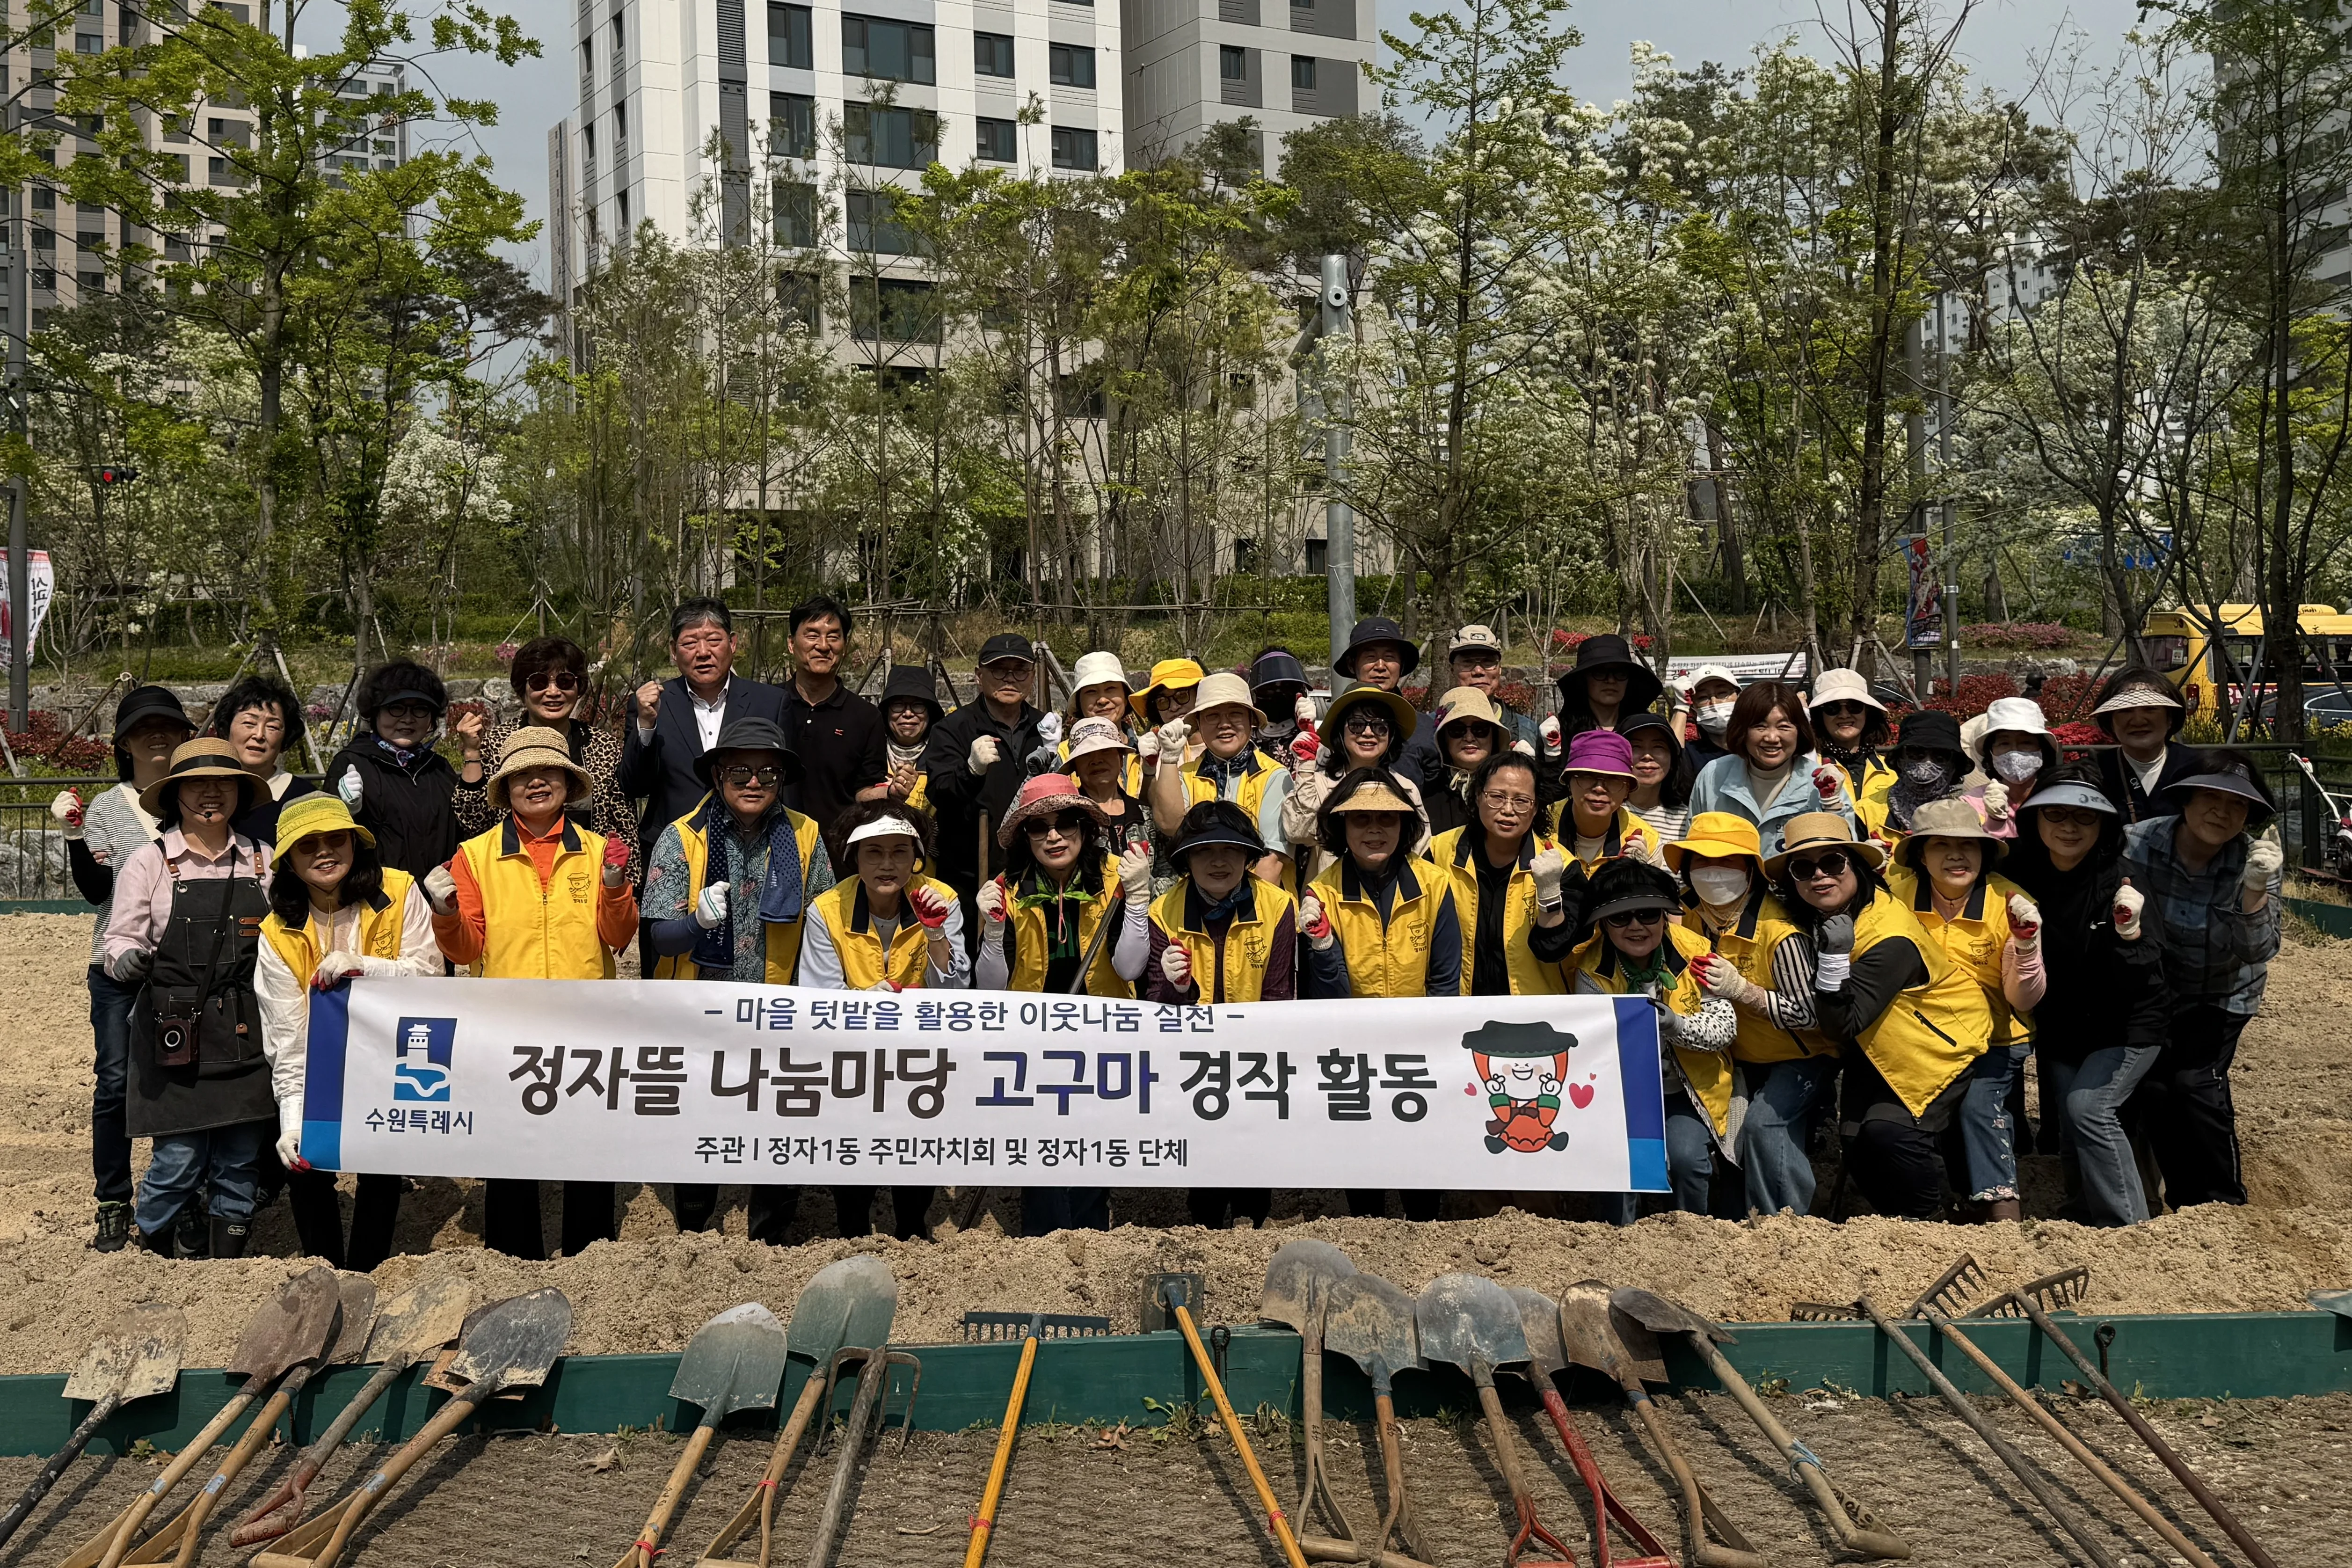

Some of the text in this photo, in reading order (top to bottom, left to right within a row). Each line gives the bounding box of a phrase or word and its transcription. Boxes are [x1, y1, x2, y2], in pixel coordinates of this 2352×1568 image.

[736, 998, 797, 1030] 마을
[811, 1000, 903, 1030] 텃밭을
[914, 1002, 1008, 1031] 활용한
[1020, 1002, 1143, 1032] 이웃나눔
[1154, 1005, 1215, 1033] 실천
[509, 1046, 1437, 1123] 정자뜰 나눔마당 고구마 경작 활동
[365, 1108, 473, 1135] 수원특례시
[694, 1136, 745, 1164] 주관
[768, 1137, 861, 1166] 정자1동
[868, 1137, 994, 1166] 주민자치회
[1005, 1138, 1027, 1166] 및
[1037, 1138, 1130, 1167] 정자1동
[1139, 1138, 1187, 1167] 단체
